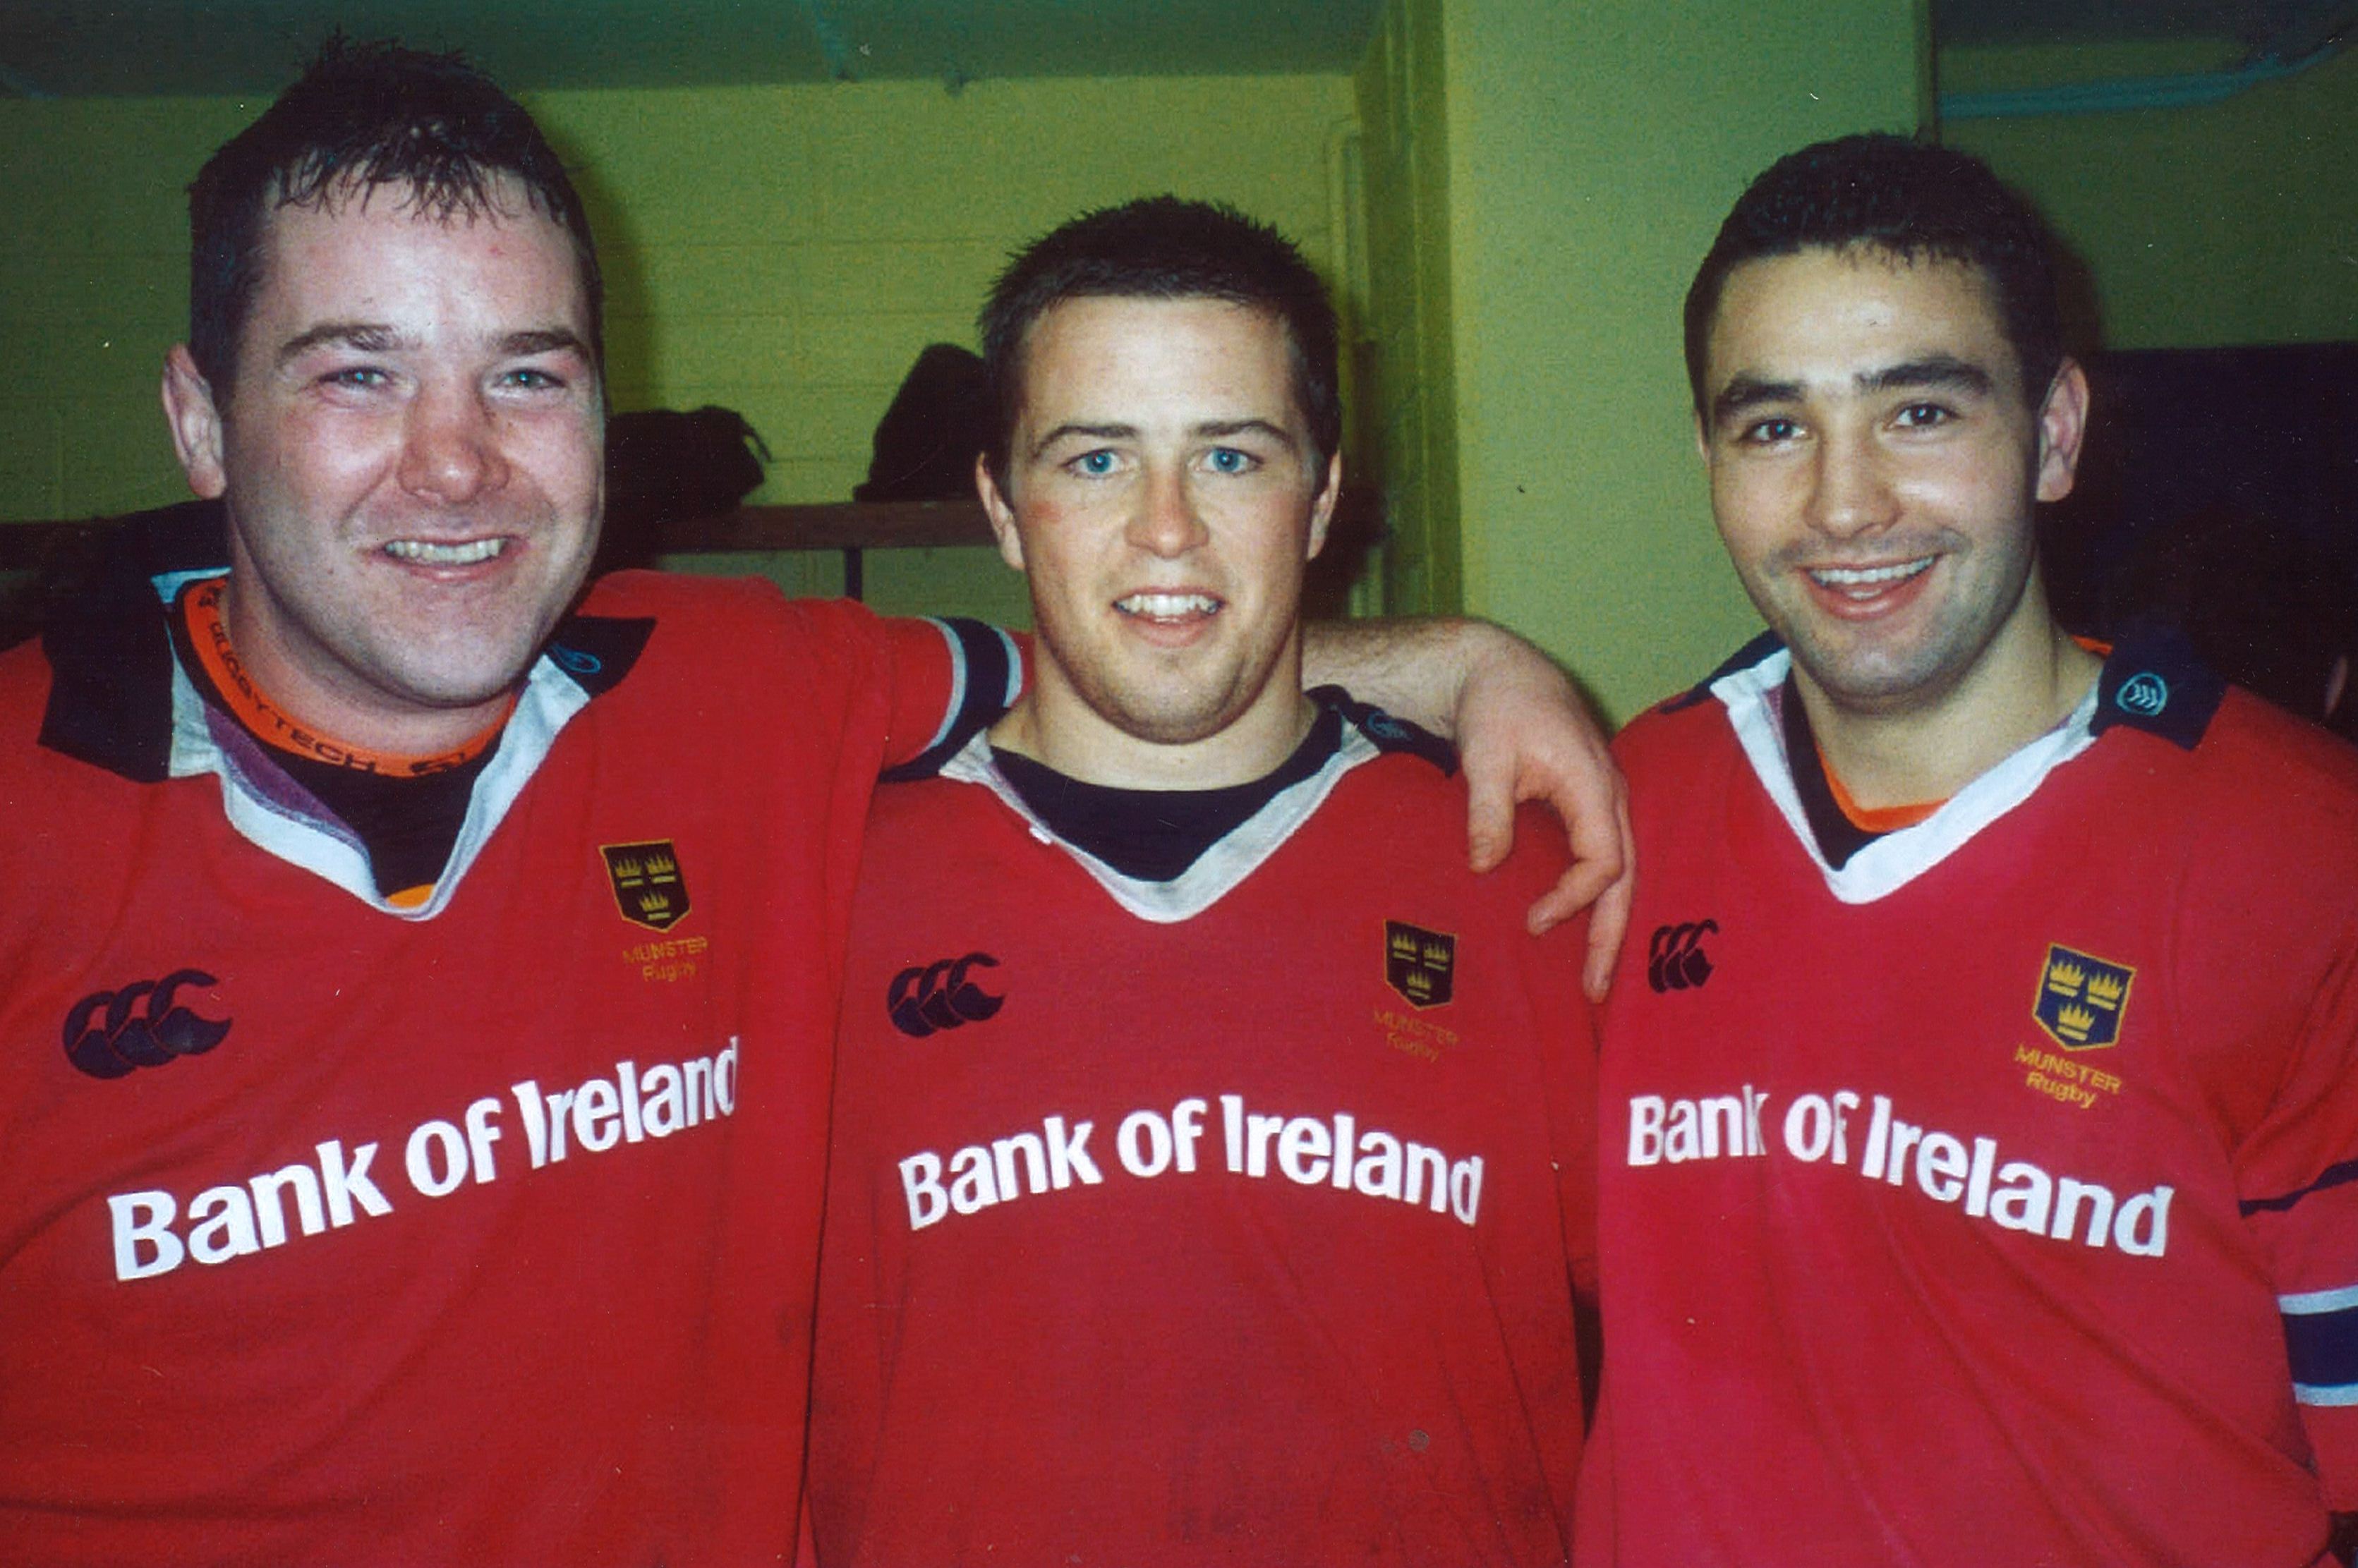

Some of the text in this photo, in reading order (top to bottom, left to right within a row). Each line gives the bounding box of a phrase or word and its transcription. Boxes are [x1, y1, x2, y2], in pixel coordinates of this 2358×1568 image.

[622, 936, 708, 964] MUNSTER
[2014, 1043, 2123, 1095] MUNSTER
[2025, 1069, 2098, 1110] Rugby
[107, 1140, 394, 1282] Bank
[511, 1035, 739, 1169] Ireland
[898, 1114, 1104, 1231] Bank
[1219, 1093, 1485, 1227] Ireland
[1627, 1084, 1770, 1167] Bank
[1861, 1094, 2175, 1258] Ireland
